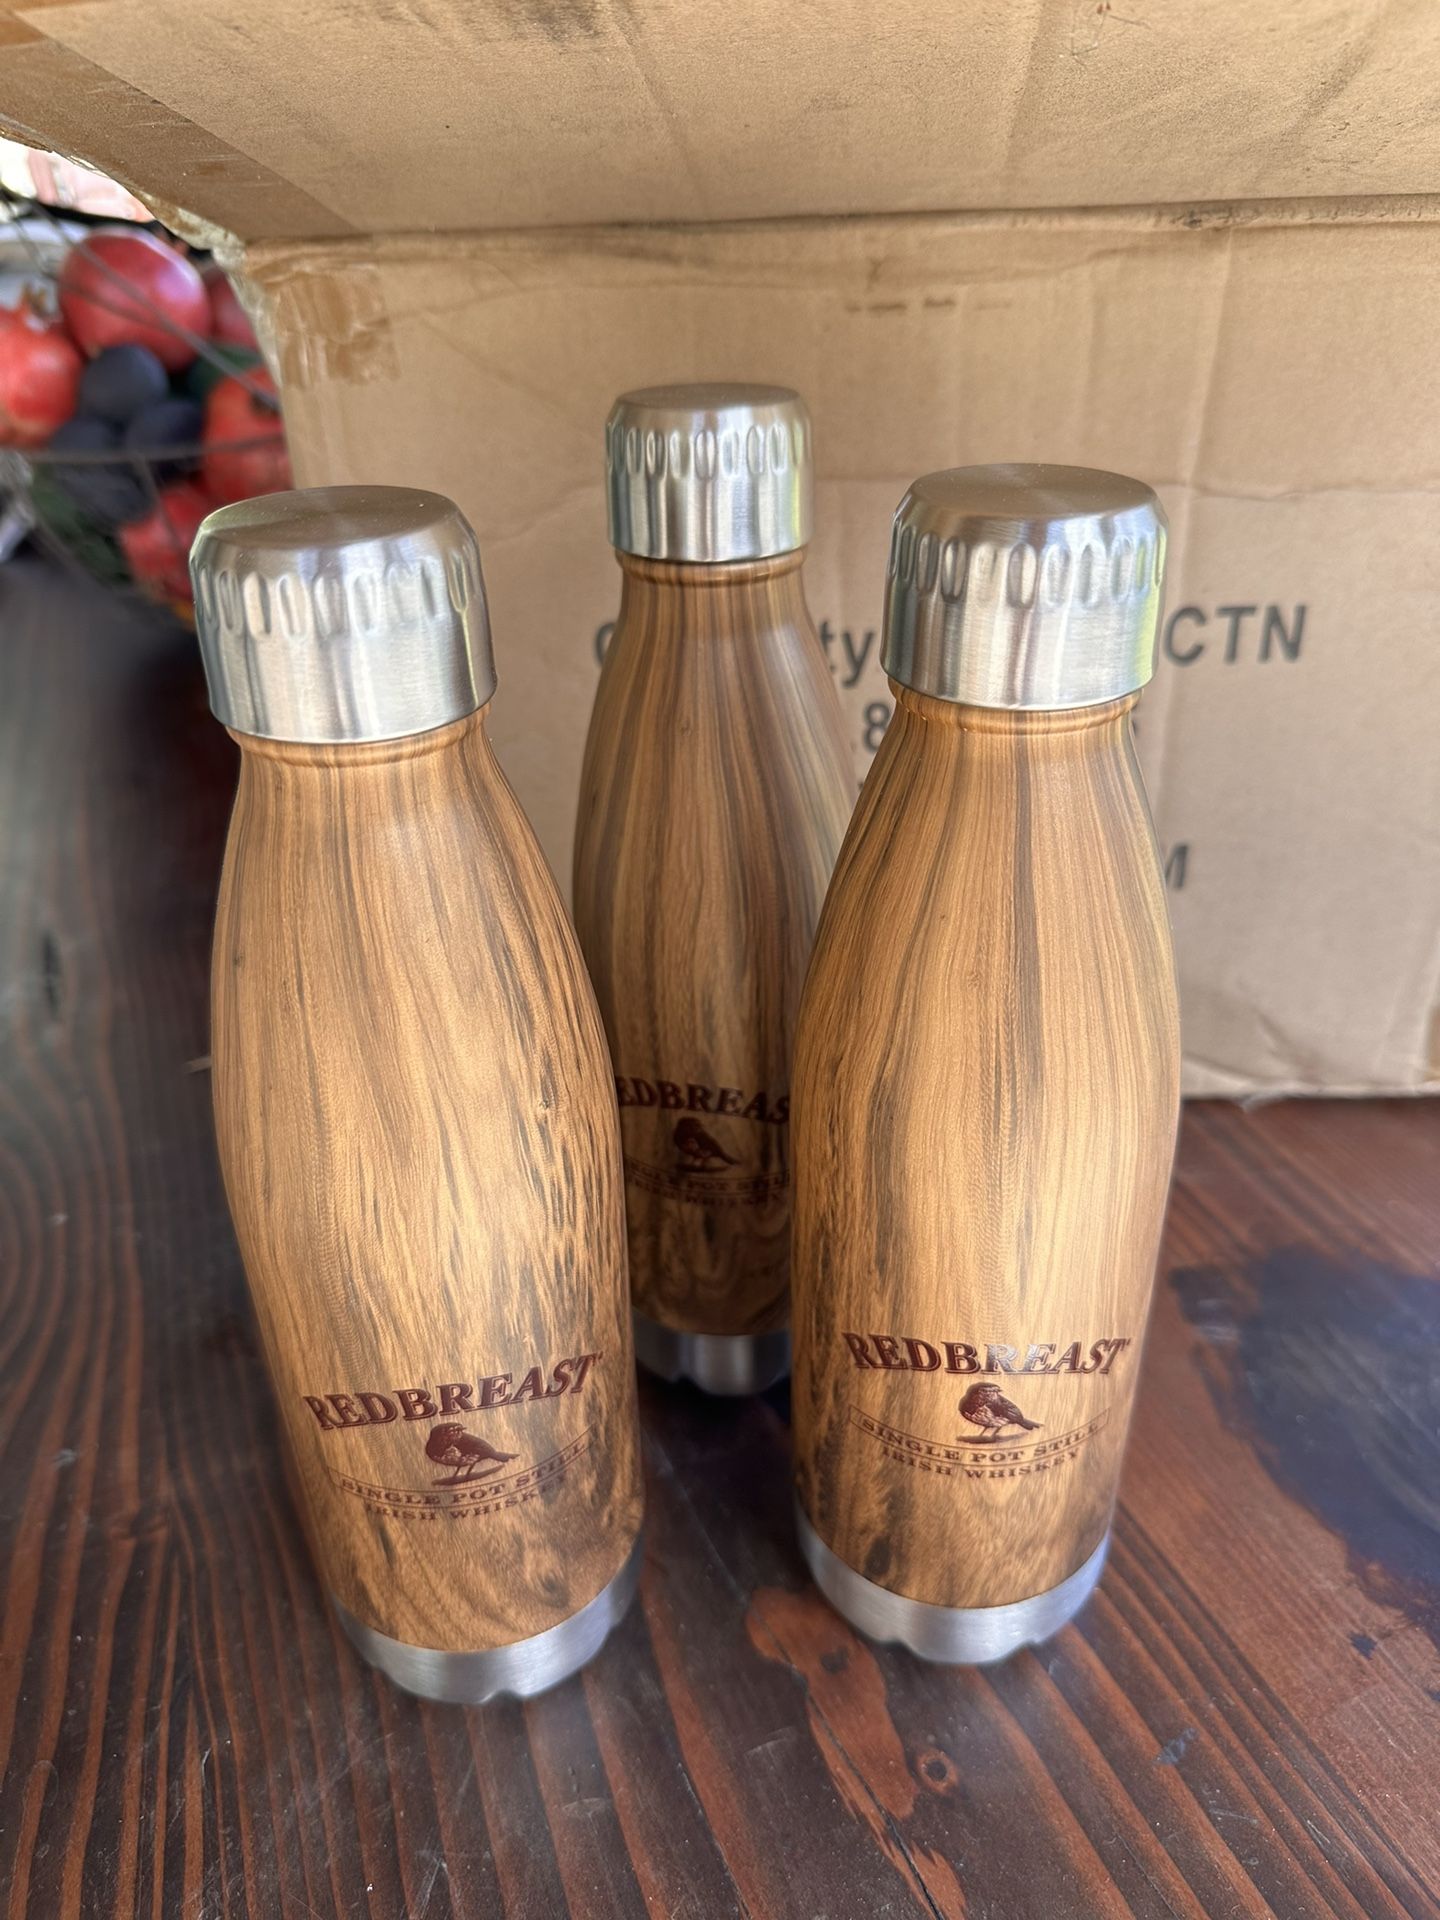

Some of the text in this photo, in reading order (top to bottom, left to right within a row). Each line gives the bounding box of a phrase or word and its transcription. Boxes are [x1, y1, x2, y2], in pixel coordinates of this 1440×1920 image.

[615, 1075, 790, 1124] EDBREAS
[842, 1332, 1132, 1375] REDBREAST
[302, 1350, 603, 1431] REDBREAST
[861, 1418, 1099, 1463] SINGLE POT STILL
[881, 1446, 1080, 1480] IRISH WHISKEY
[340, 1442, 586, 1505] SINGLE POT STILL
[364, 1502, 437, 1521] IRISH
